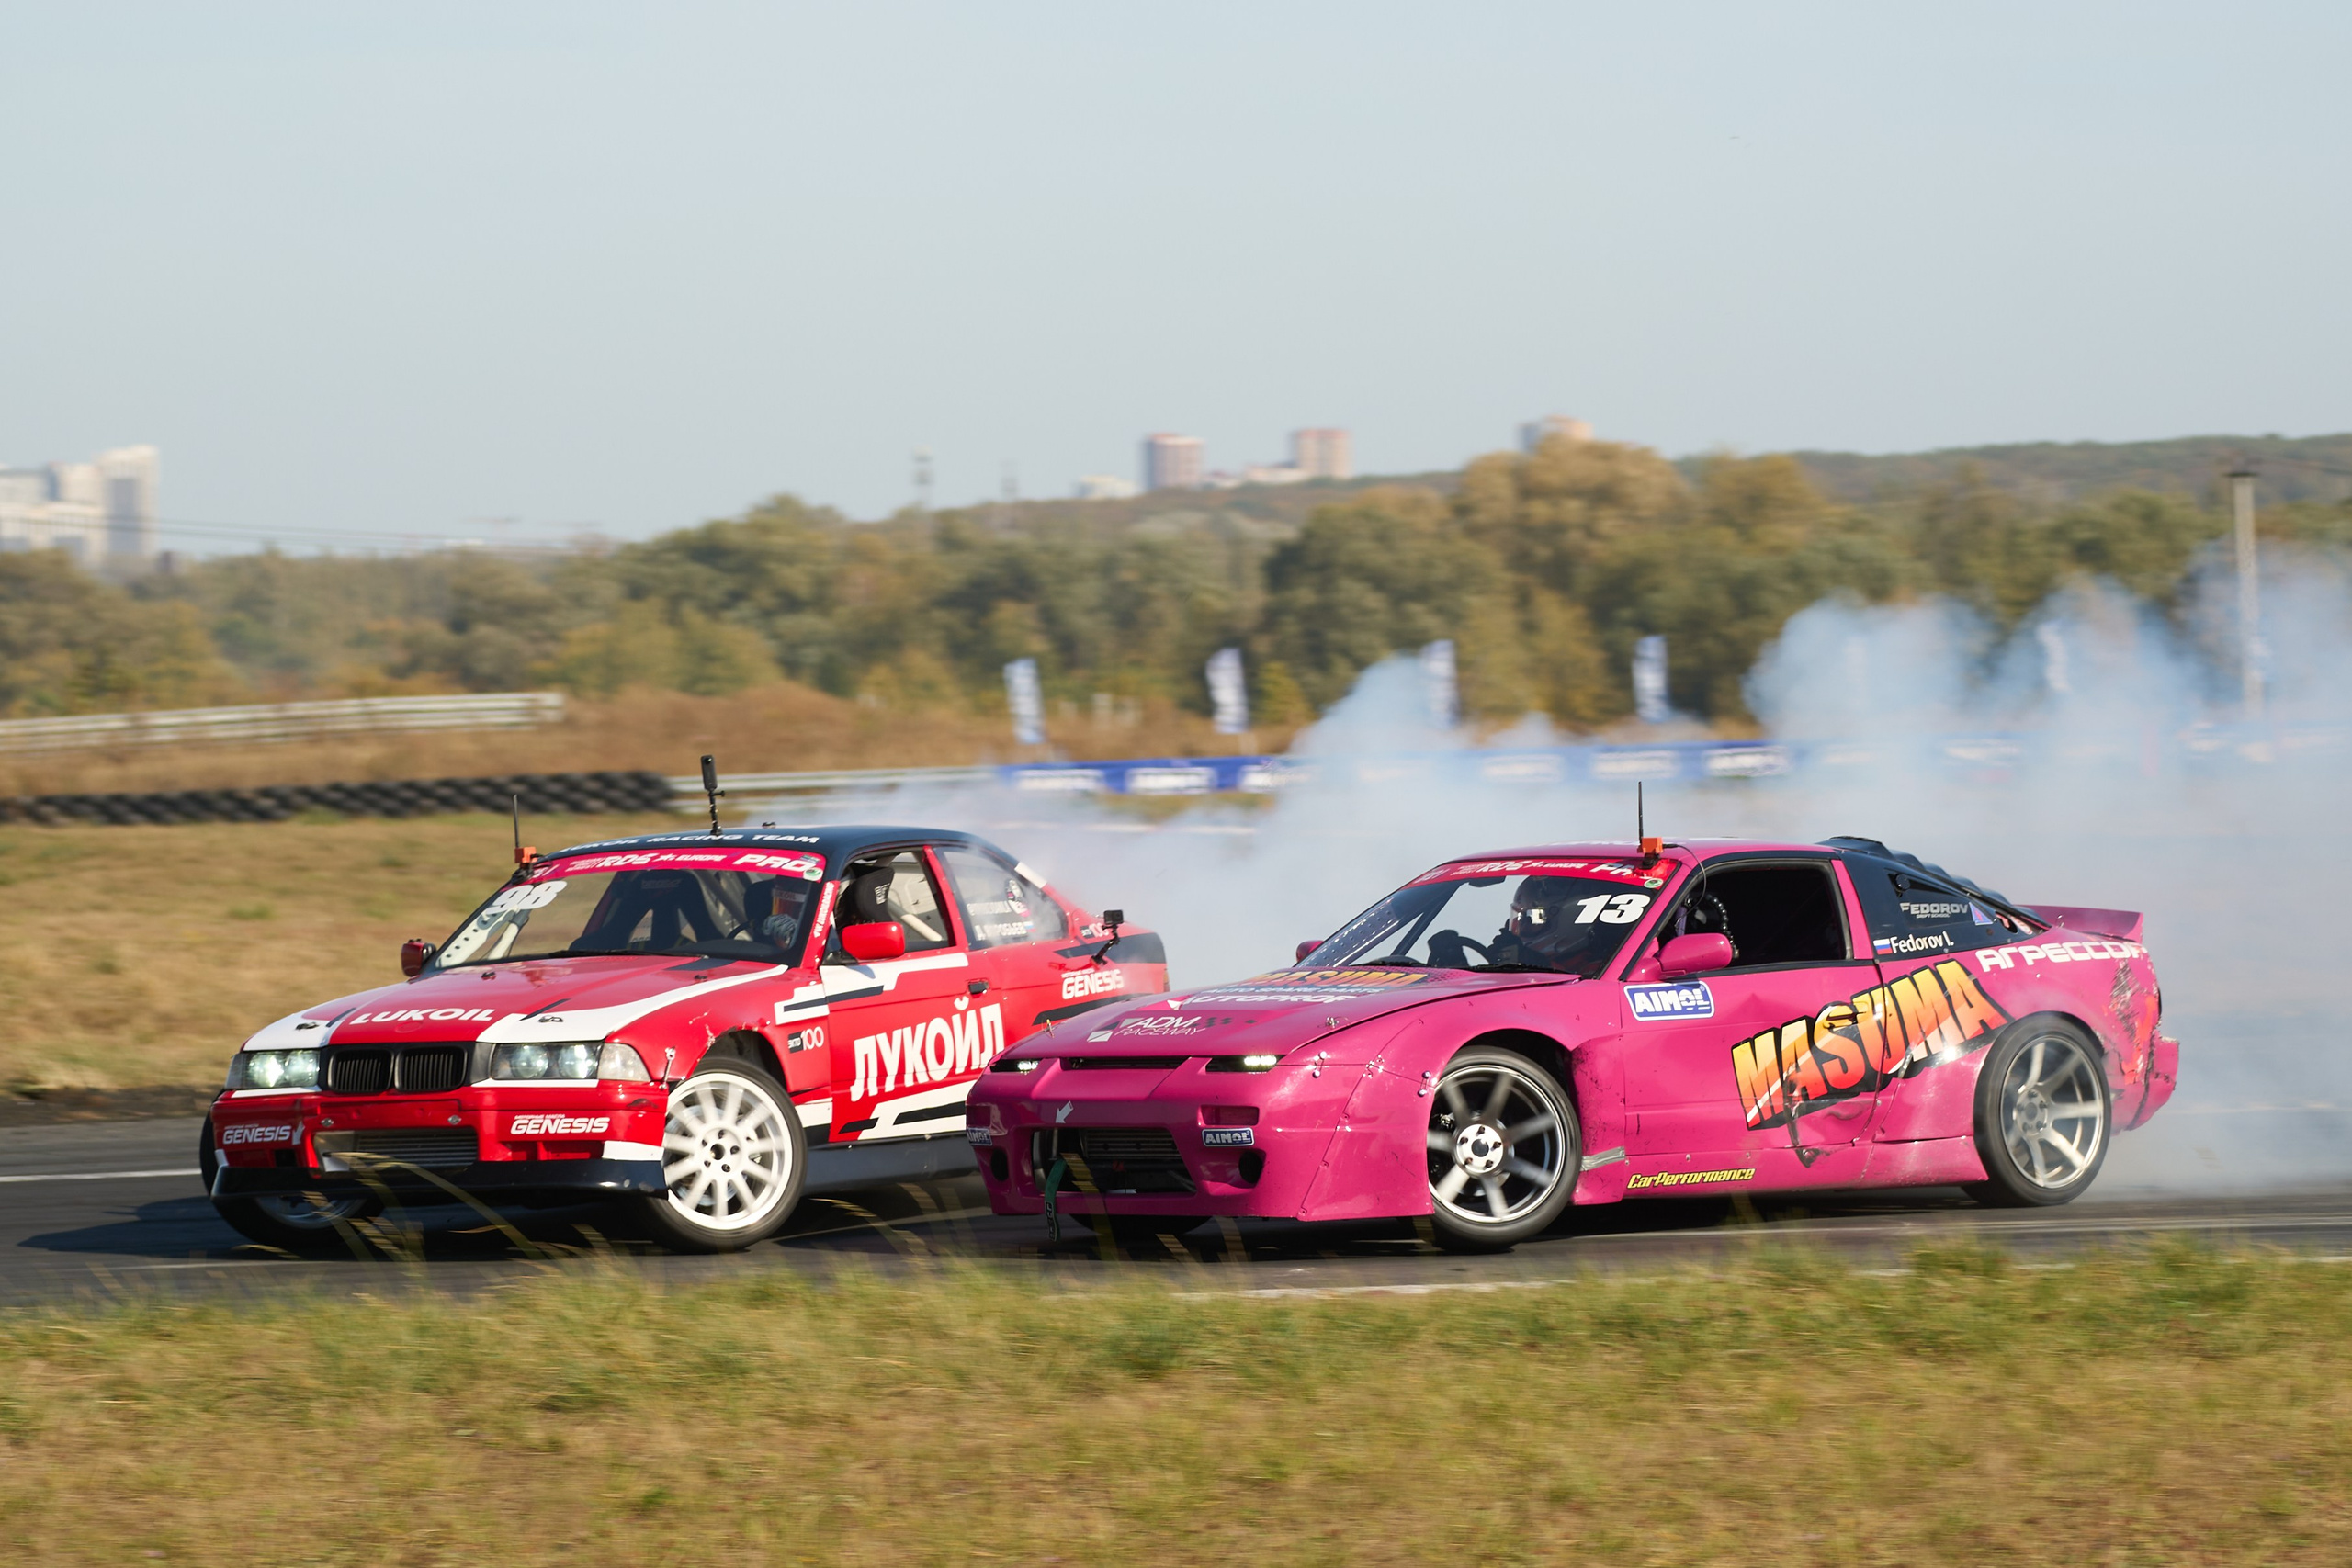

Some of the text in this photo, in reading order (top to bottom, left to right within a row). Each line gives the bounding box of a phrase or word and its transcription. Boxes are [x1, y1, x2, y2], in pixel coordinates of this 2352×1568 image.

[752, 835, 820, 843] TEAM
[597, 853, 658, 868] RDS
[732, 853, 817, 872] PRO
[483, 880, 567, 915] 98
[1574, 894, 1651, 924] 13
[1900, 902, 1968, 915] FEDOROV
[1890, 932, 1944, 953] Fedorov
[1062, 969, 1124, 1000] GENESIS
[1634, 988, 1711, 1013] AIMOL
[349, 1008, 495, 1025] LUKOIL
[1127, 1016, 1202, 1029] ADM
[800, 1026, 824, 1051] 100
[1114, 1027, 1206, 1036] RACEWAY
[850, 996, 1004, 1102] ЛУКОЙЛ
[1732, 960, 2008, 1128] MASUMA
[222, 1125, 291, 1145] GENESIS
[510, 1117, 610, 1134] GENESIS
[1205, 1131, 1251, 1144] AIMOL
[1627, 1168, 1756, 1189] CarPerformance
